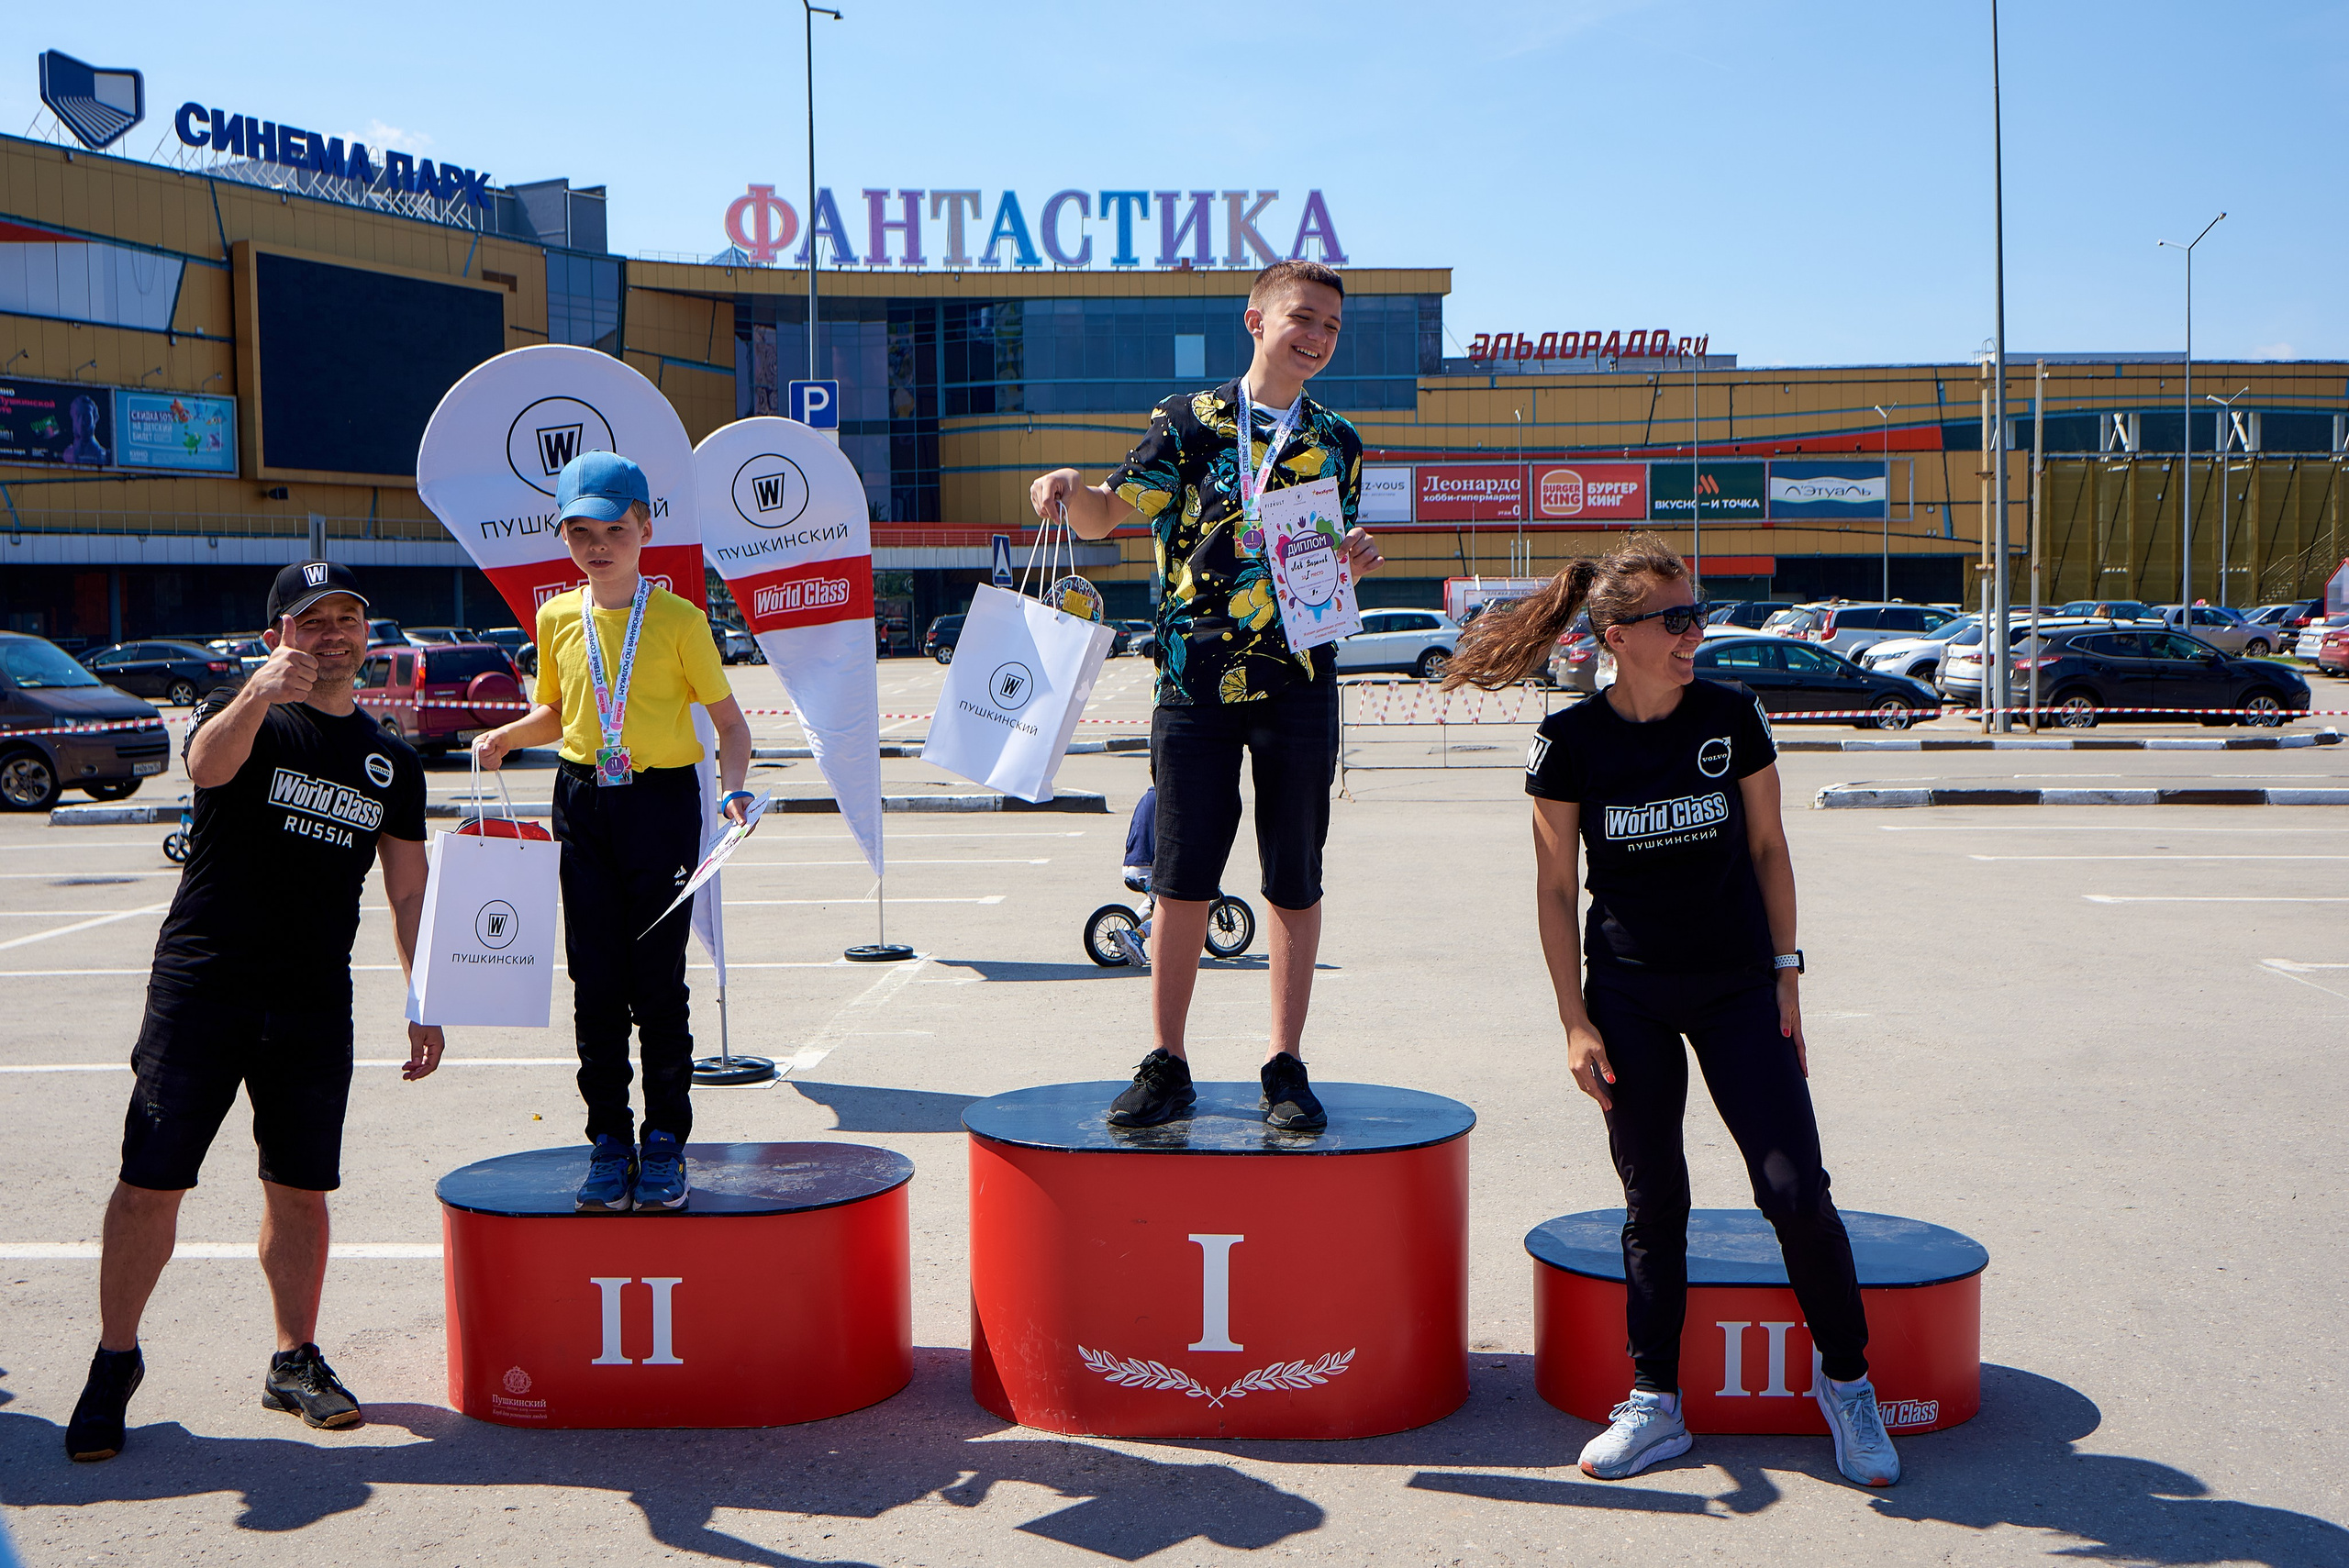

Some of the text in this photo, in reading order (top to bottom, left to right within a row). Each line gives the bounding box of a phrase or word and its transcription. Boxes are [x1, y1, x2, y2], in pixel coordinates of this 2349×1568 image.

[175, 102, 492, 209] СИНЕМА ПАРК
[725, 183, 1348, 267] ФАНТАСТИКА
[804, 386, 829, 425] P
[1240, 395, 1249, 443] СОРЕВНОВАНИЯ
[544, 430, 575, 470] W
[757, 477, 780, 508] W
[1423, 475, 1520, 494] Леонардо
[1542, 484, 1581, 494] BURGER
[1587, 482, 1638, 494] БУРГЕР
[1542, 493, 1581, 506] KING
[1587, 495, 1622, 506] КИНГ
[1711, 499, 1719, 509] И
[1721, 498, 1760, 509] ТОЧКА
[718, 523, 849, 561] ПУШКИНСКИЙ
[1287, 535, 1327, 557] ДИПЛОМ
[308, 565, 325, 584] W
[756, 580, 847, 615] World Class
[629, 595, 645, 651] СОРЕВНОВАНИЯ
[624, 651, 631, 661] ПО
[593, 653, 603, 684] СЕТЕВЫЕ
[618, 660, 629, 695] РОЛИКАМ
[1006, 678, 1019, 694] W
[959, 700, 1039, 736] ПУШКИНСКИЙ
[369, 763, 391, 775] VOLVO
[1702, 752, 1728, 762] VOLVO
[273, 773, 381, 828] World Class
[1609, 793, 1726, 836] World Class
[284, 815, 353, 848] RUSSIA
[1628, 828, 1718, 852] ПУШКИНСКИЙ
[490, 917, 505, 934] W
[451, 953, 535, 965] ПУШКИНСКИЙ
[1188, 1234, 1244, 1351] I
[590, 1277, 684, 1364] II
[492, 1394, 547, 1408] Пушкинский
[1856, 1388, 1871, 1397] HOKA
[1898, 1400, 1938, 1424] Class
